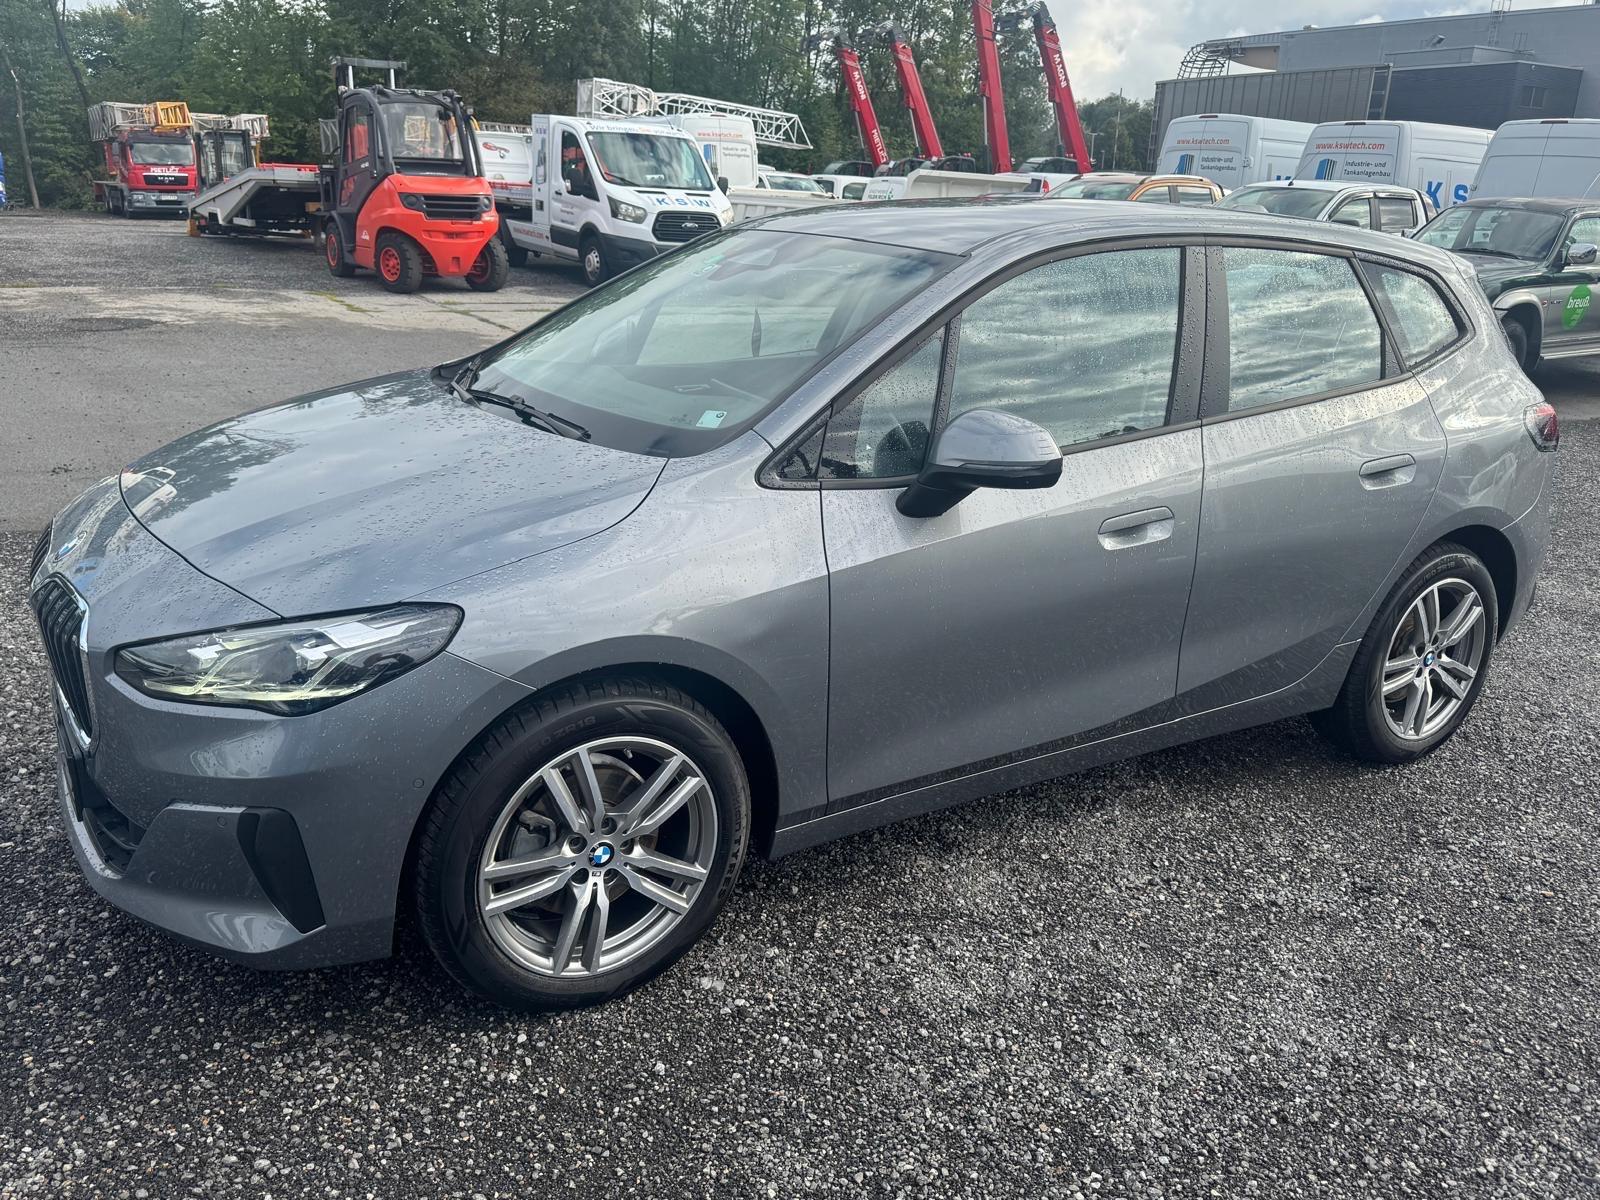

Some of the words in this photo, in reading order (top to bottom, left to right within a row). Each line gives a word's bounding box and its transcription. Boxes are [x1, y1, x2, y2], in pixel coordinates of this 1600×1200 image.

[1176, 137, 1230, 145] www.kswtech.com
[1315, 140, 1385, 150] www.kswtech.com
[1345, 160, 1374, 168] Industrie-
[1343, 168, 1391, 178] Tankanlagenbau
